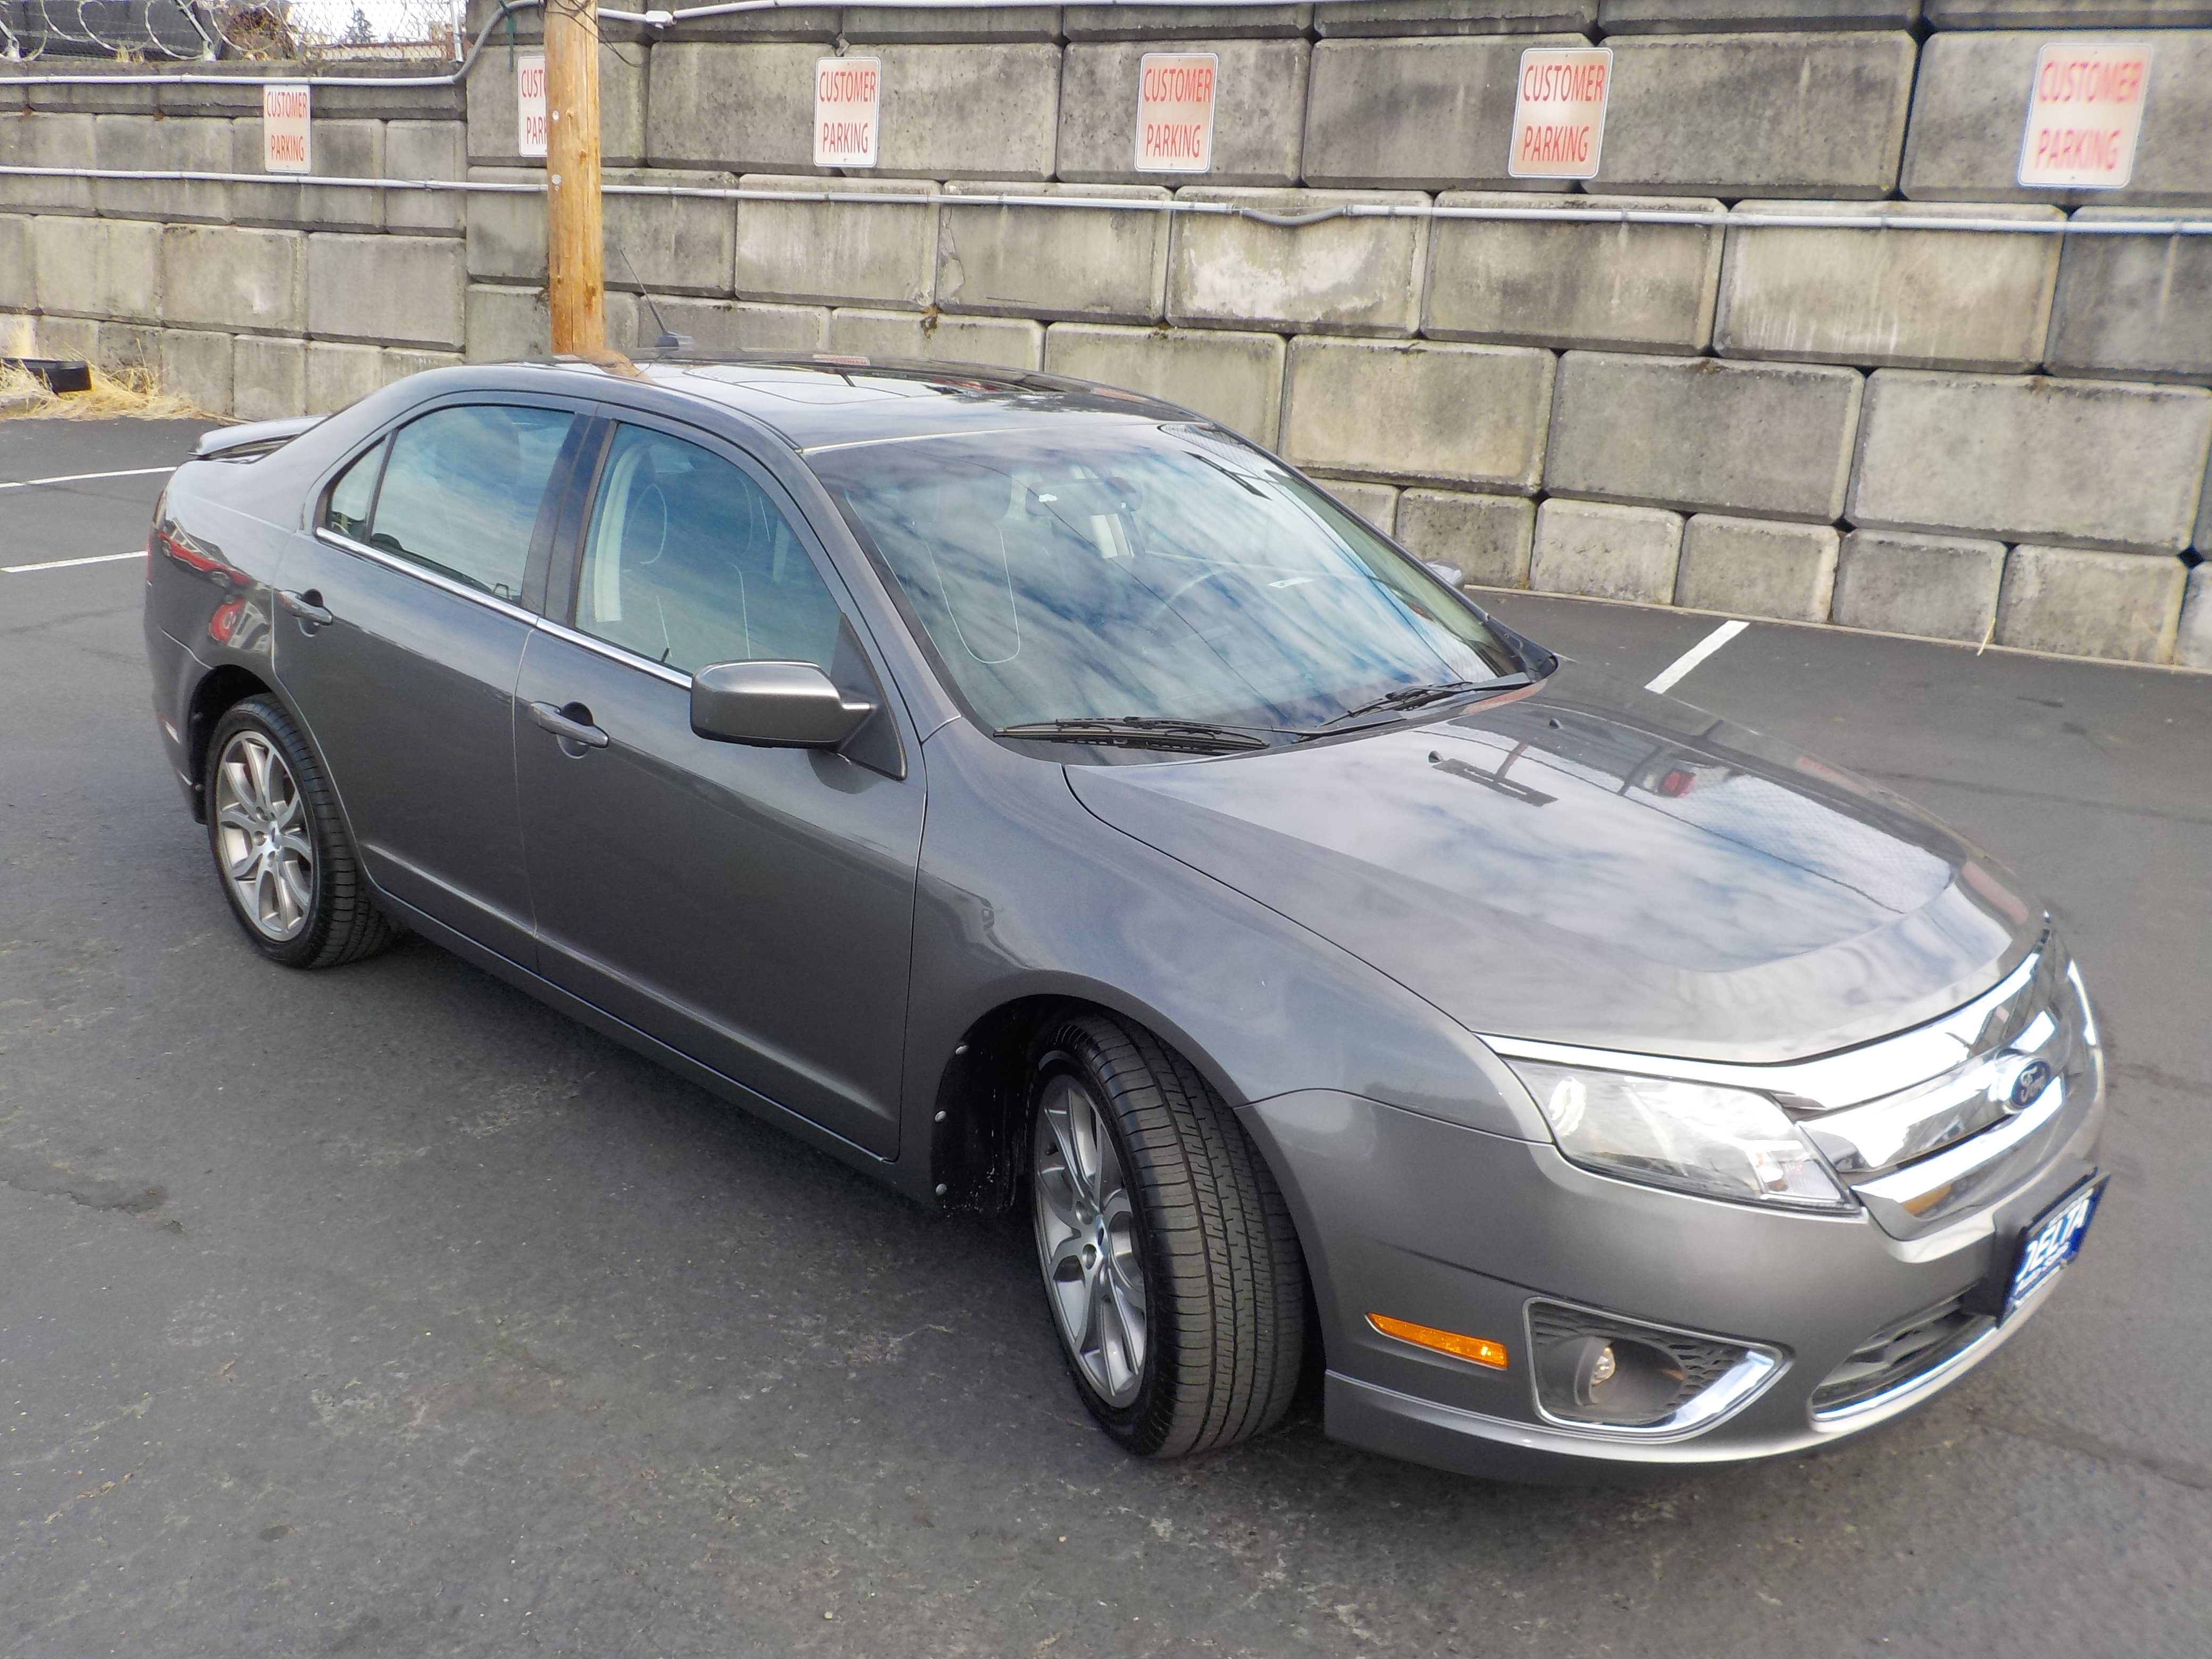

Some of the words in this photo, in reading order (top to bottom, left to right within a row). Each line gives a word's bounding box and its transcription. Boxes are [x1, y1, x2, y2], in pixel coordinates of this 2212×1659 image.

[521, 70, 546, 98] CUST
[819, 71, 876, 102] CUSTOMER
[1144, 69, 1212, 102] CUSTOMER
[1523, 65, 1605, 102] CUSTOMER
[2041, 62, 2142, 102] CUSTOMER
[267, 91, 307, 118] CUSTOMER
[271, 135, 304, 161] PARKING
[823, 122, 868, 153] PARKING
[1146, 124, 1201, 157] PARKING
[1523, 125, 1589, 162] PARKING
[2035, 129, 2121, 170] PARKING
